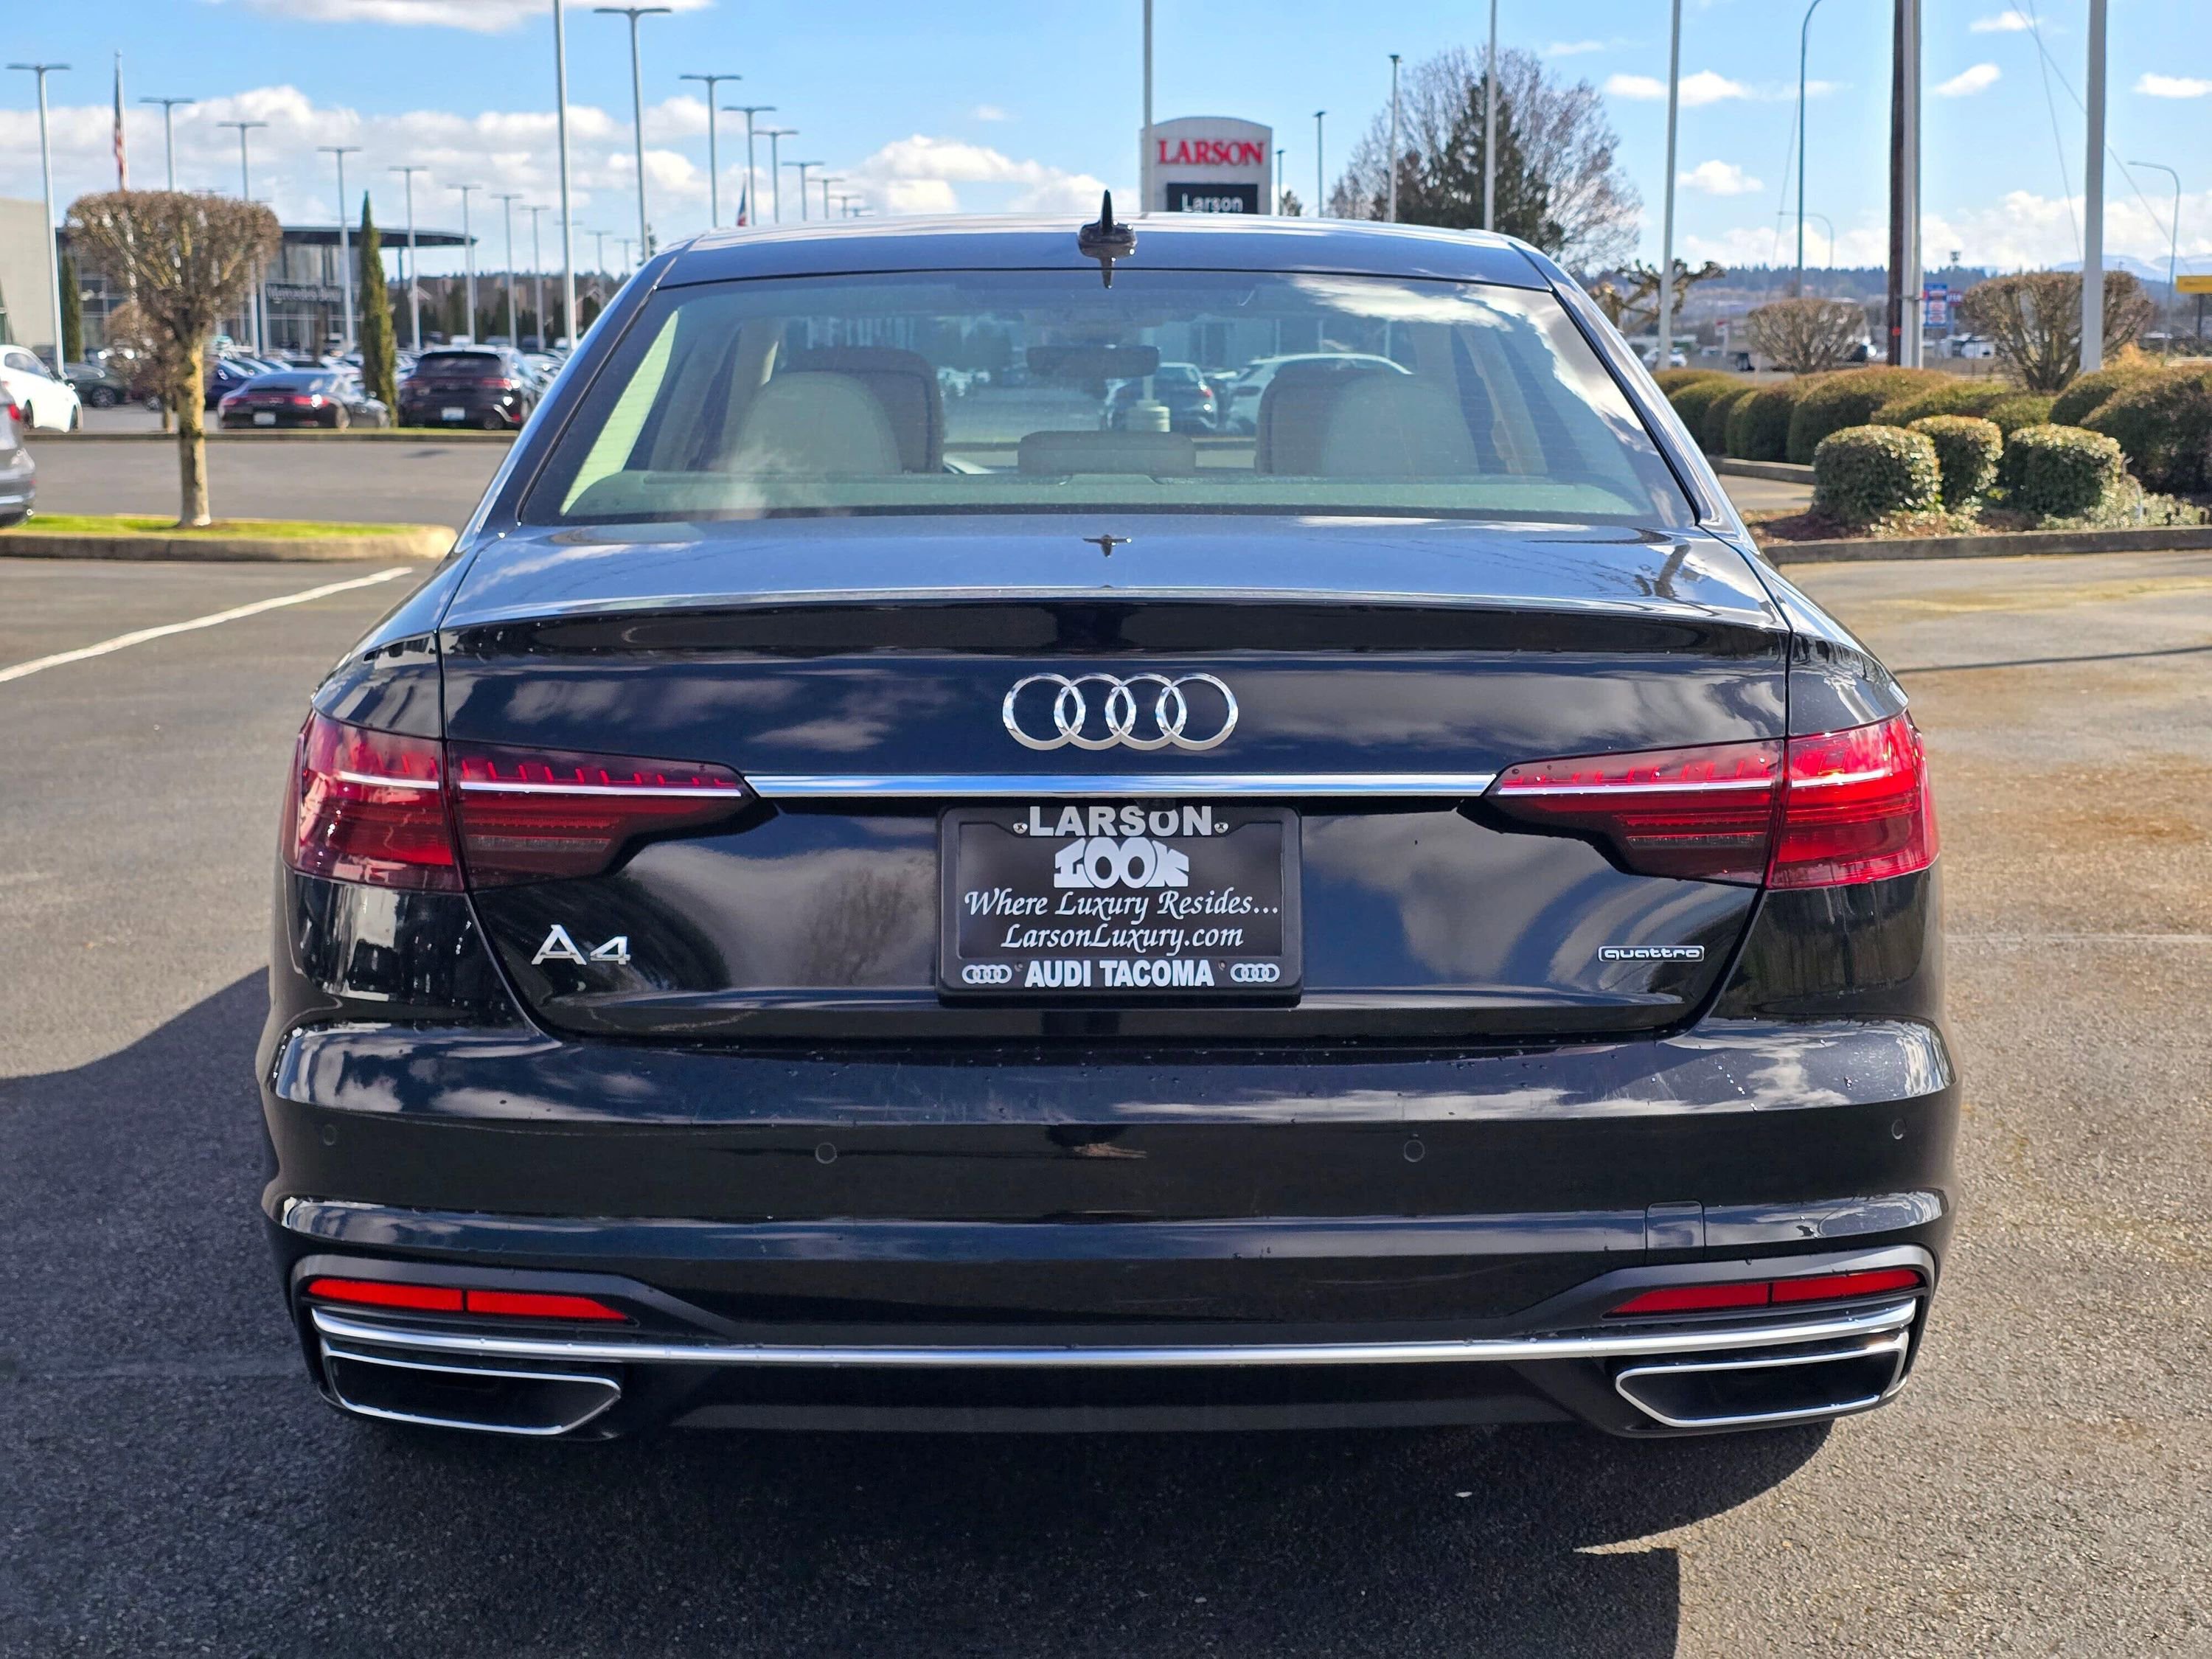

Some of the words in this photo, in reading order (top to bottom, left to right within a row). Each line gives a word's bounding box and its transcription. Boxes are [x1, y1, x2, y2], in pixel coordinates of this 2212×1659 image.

[1158, 138, 1265, 165] LARSON
[1182, 192, 1244, 212] Larson
[1029, 806, 1211, 836] LARSON
[964, 888, 1047, 916] Where
[1054, 891, 1149, 925] Luxury
[1157, 888, 1279, 919] Resides...
[531, 924, 631, 965] A4
[1001, 924, 1244, 956] LarsonLuxury.com
[1604, 947, 1700, 961] quattro
[1025, 960, 1091, 987] AUDI
[1099, 960, 1215, 987] TACOMA
